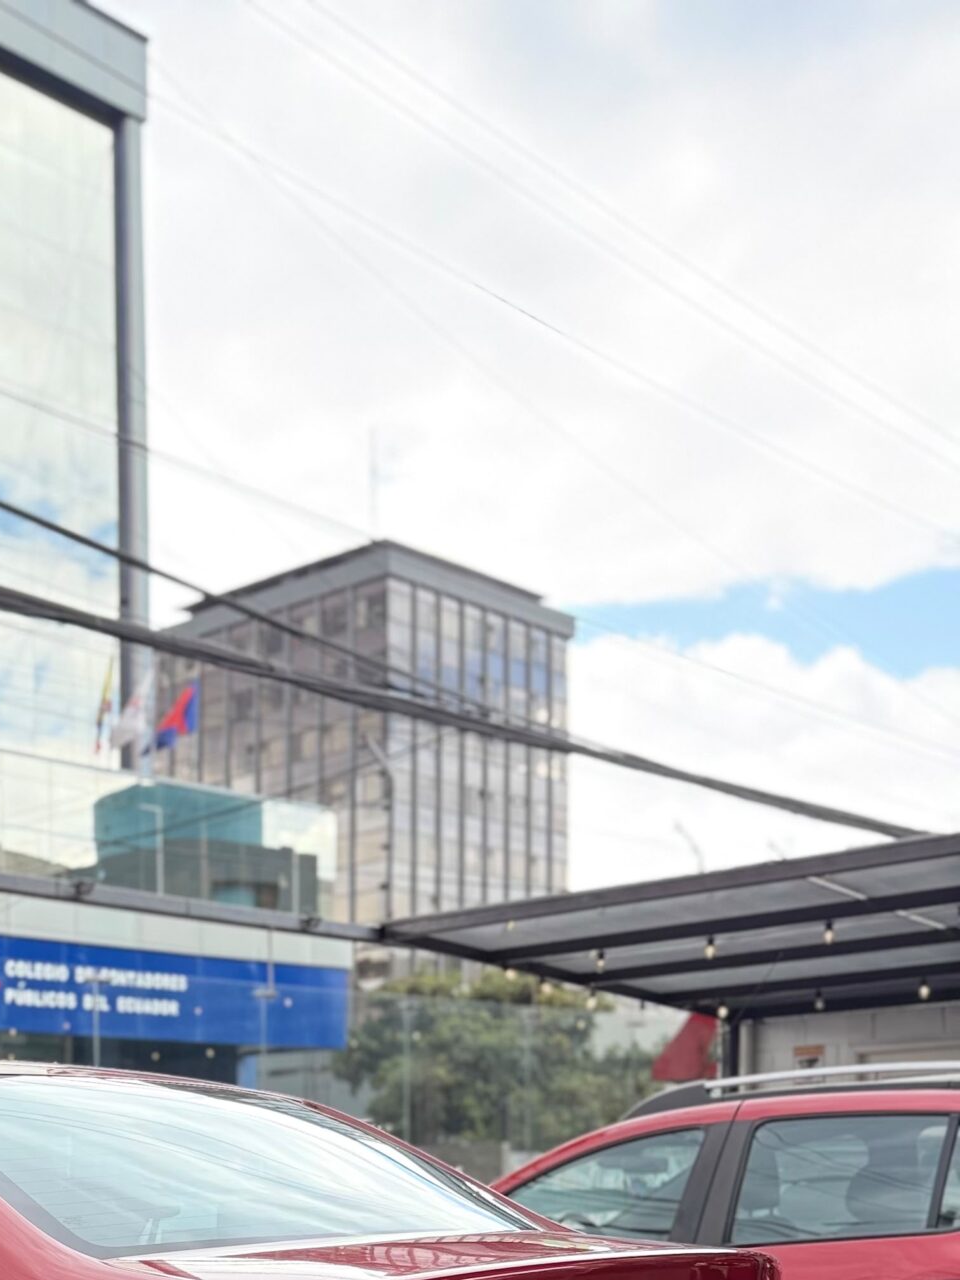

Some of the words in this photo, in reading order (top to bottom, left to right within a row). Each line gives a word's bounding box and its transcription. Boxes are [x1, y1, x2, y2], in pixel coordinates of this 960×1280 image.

[4, 959, 70, 983] COLEGIO
[82, 993, 111, 1013] DEL
[116, 995, 180, 1017] ECUADOR
